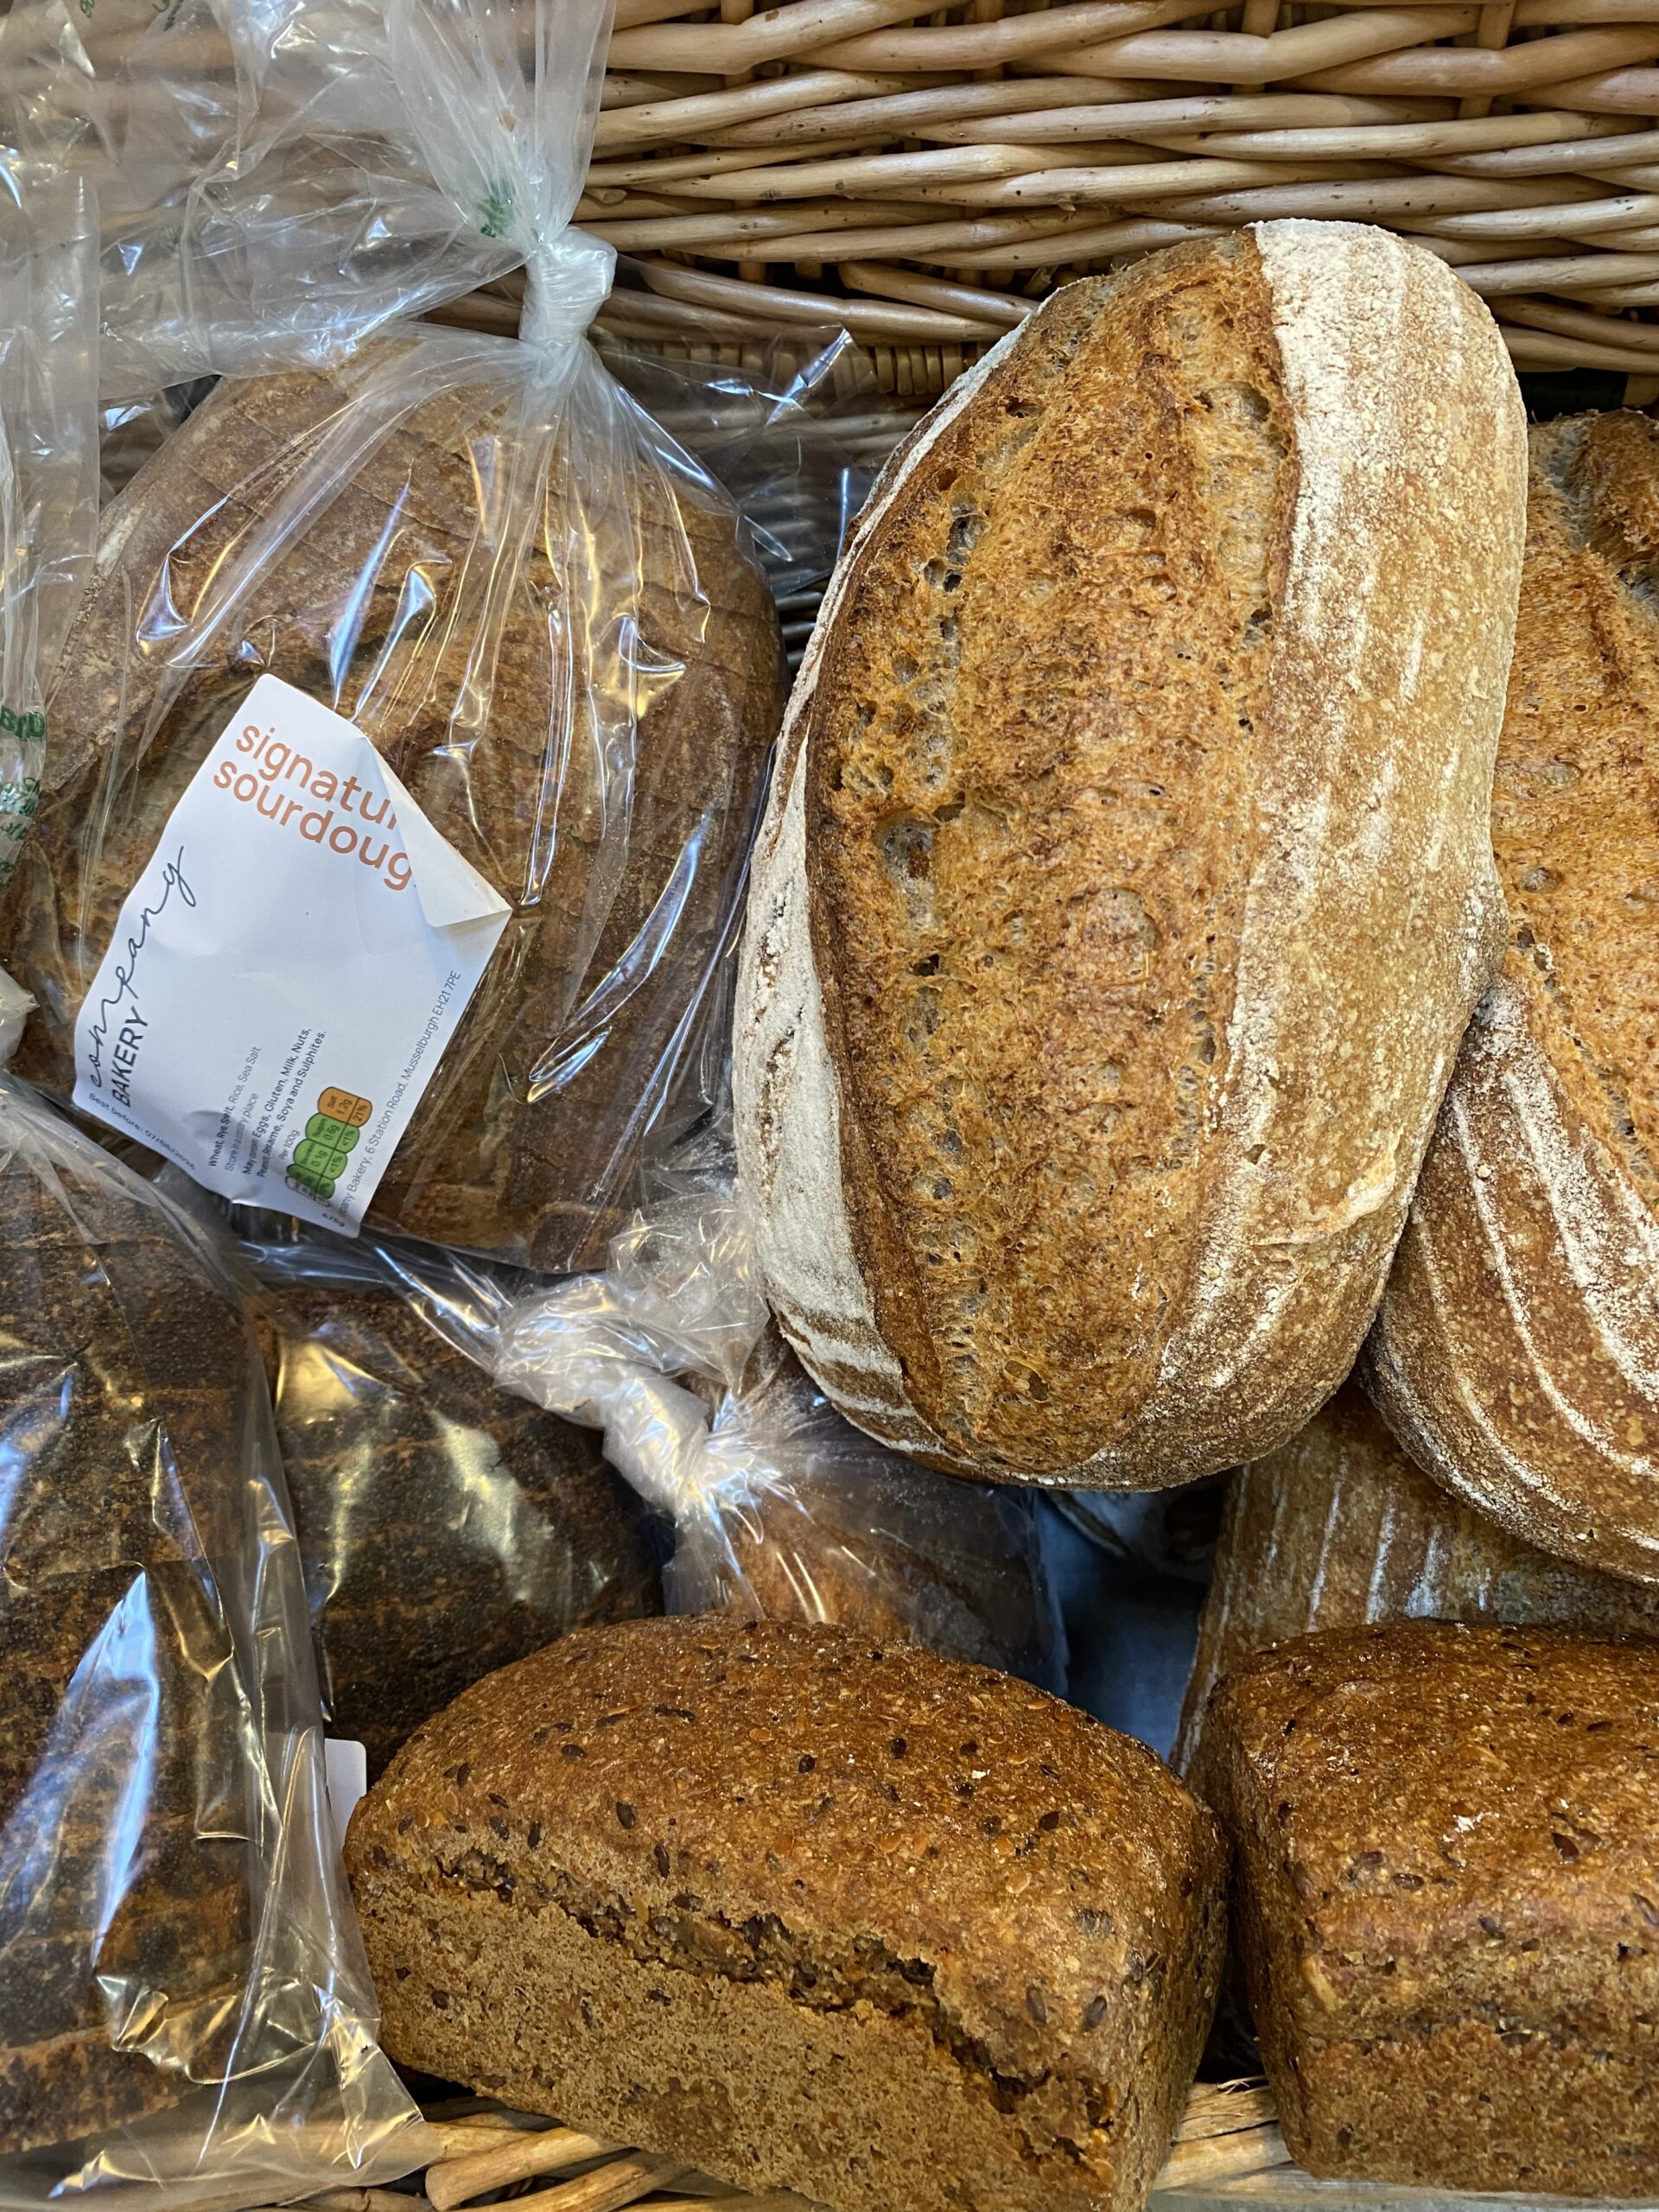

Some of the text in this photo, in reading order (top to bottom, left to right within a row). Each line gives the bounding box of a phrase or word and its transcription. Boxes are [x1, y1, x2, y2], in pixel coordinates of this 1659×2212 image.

[112, 1006, 149, 1107] BAKERY
[238, 1065, 252, 1082] Sea
[245, 1046, 261, 1065] Salt
[369, 1110, 393, 1146] Station
[401, 1017, 439, 1080] Musselburgh
[432, 991, 450, 1015] EH21
[444, 970, 461, 991] 7PE
[252, 1115, 271, 1138] Eggs,
[264, 1079, 288, 1111] Gluten,
[281, 1056, 299, 1076] Milk,
[291, 1028, 312, 1052] Nuts,
[276, 1098, 295, 1122] Soya
[290, 1078, 303, 1096] and
[297, 1032, 326, 1077] Sulphites.
[90, 1093, 110, 1110] Best
[243, 1093, 258, 1118] place
[283, 1130, 300, 1147] 100g
[226, 1150, 238, 1171] Store
[242, 1158, 256, 1174] May
